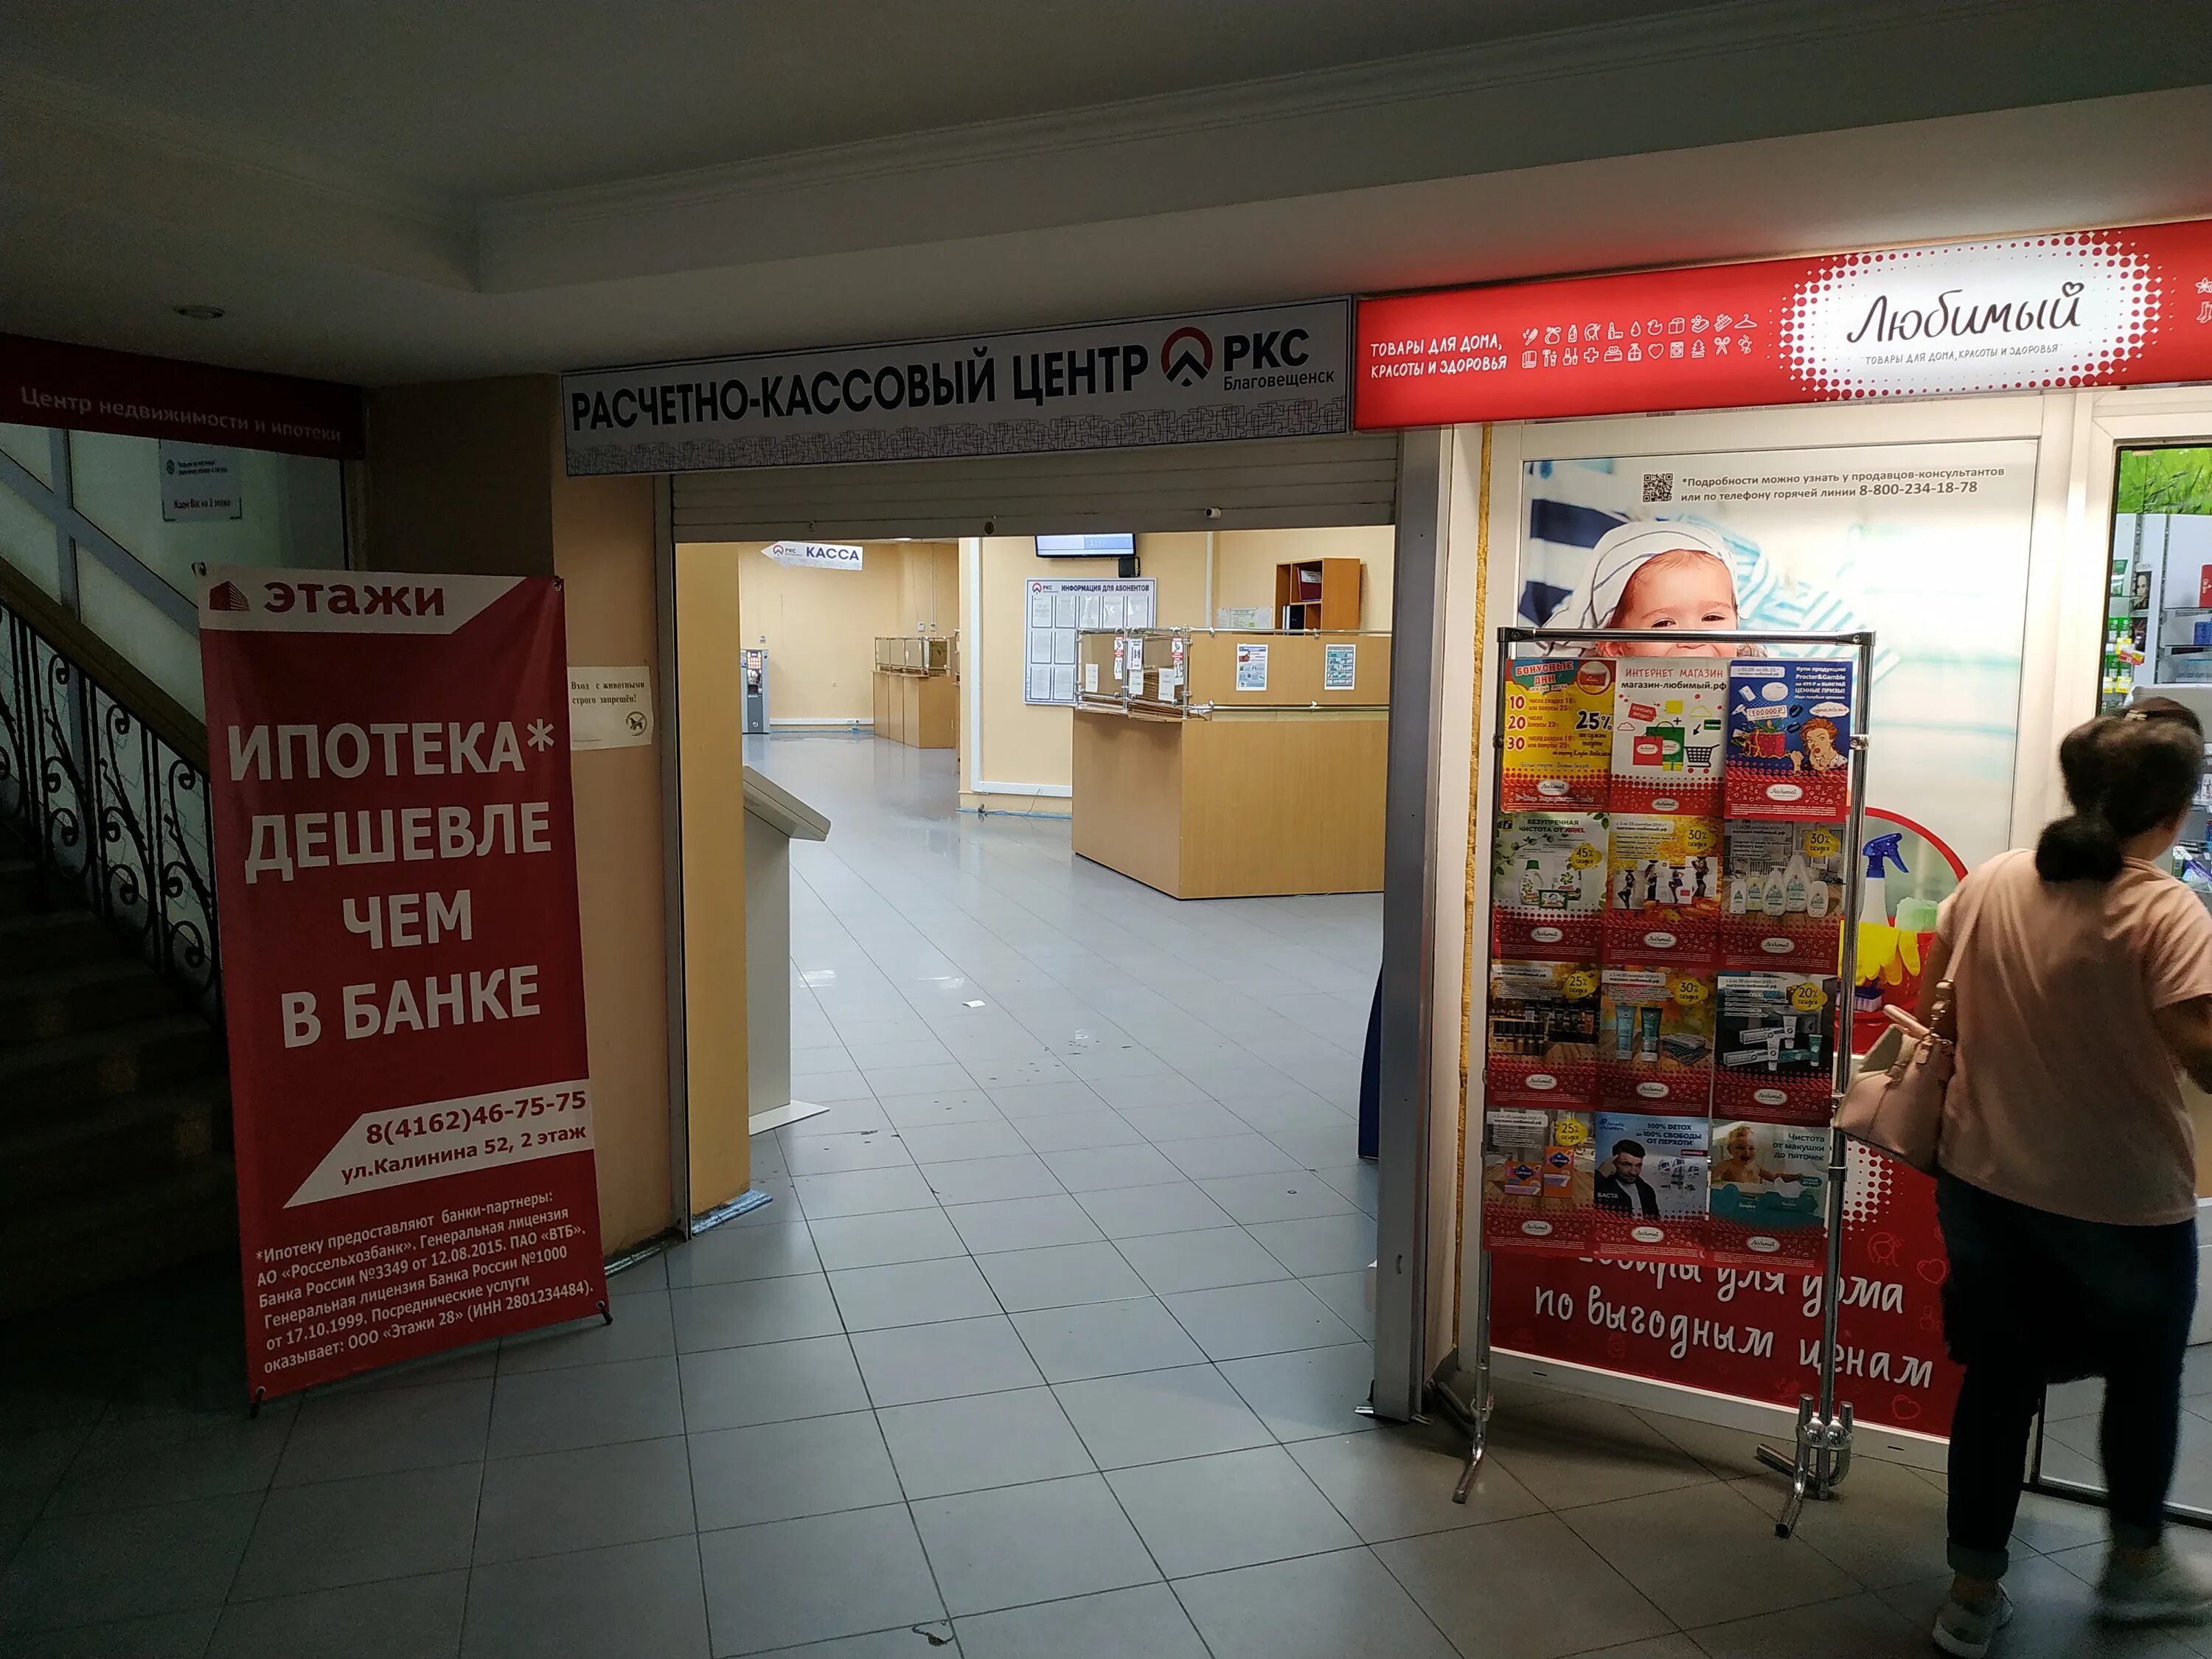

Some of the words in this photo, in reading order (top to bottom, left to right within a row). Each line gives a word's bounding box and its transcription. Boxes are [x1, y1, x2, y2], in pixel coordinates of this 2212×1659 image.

[1846, 282, 2084, 344] Любимый
[1224, 328, 1309, 372] РКС
[1371, 337, 1425, 358] ТОВАРЫ
[1427, 335, 1457, 355] ДЛЯ
[1460, 333, 1503, 352] ДОМА,
[1865, 354, 1903, 366] ТОВАРЫ
[1905, 352, 1926, 364] ДЛЯ
[2000, 346, 2007, 356] И
[2009, 344, 2059, 356] ЗДОРОВЬЯ
[1371, 361, 1425, 379] КРАСОТЫ
[1428, 361, 1436, 375] И
[1440, 355, 1507, 374] ЗДОРОВЬЯ
[572, 346, 995, 431] РАСЧЕТНО-КАССОВЫЙ
[1013, 344, 1148, 406] ЦЕНТР
[1224, 371, 1335, 392] Благовещенск
[21, 386, 92, 415] Центр
[100, 400, 248, 431] недвижимости
[254, 420, 265, 433] и
[272, 421, 341, 442] ипотеки
[1761, 476, 1800, 484] можно
[1803, 474, 1840, 485] узнать
[1842, 476, 1848, 484] у
[1851, 467, 2005, 483] продавцов-консультантов
[1681, 494, 1700, 502] или
[1703, 493, 1717, 501] по
[1719, 490, 1771, 503] телефону
[1773, 487, 1818, 501] горячей
[1820, 487, 1856, 498] линии
[1859, 481, 1978, 497] 8-800-234-18-78
[806, 546, 859, 560] КАССА
[1061, 585, 1102, 593] ИНФОРМАЦИЯ
[1102, 585, 1114, 593] ДЛЯ
[1516, 661, 1573, 675] БОНУСНЫЕ
[1625, 668, 1674, 678] ИНТЕРНЕТ
[1680, 668, 1723, 678] МАГАЗИН
[571, 681, 589, 690] Вход
[1621, 681, 1727, 691] магазин-любимый.рф
[572, 697, 597, 706] строго
[600, 694, 637, 705] запрещён!
[1509, 695, 1526, 710] 10
[1507, 715, 1526, 731] 20
[1575, 710, 1613, 731] 25%
[1506, 736, 1526, 751] 30
[244, 801, 552, 885] ДЕШЕВЛЕ
[1688, 830, 1707, 840] 30%
[1811, 834, 1830, 844] 30%
[1576, 848, 1593, 858] 45%
[342, 888, 473, 950] ЧЕМ
[1570, 976, 1587, 987] 25%
[1680, 983, 1698, 993] 30%
[1798, 987, 1818, 998] 20%
[281, 991, 321, 1048] В
[342, 964, 540, 1040] БАНКЕ
[366, 1091, 587, 1145] 8(4162)46-75-75
[1562, 1124, 1579, 1134] 25%
[1788, 1133, 1825, 1142] Чистота
[341, 1144, 478, 1184] ул.Калинина
[484, 1136, 514, 1155] 52,
[521, 1133, 532, 1148] 2
[538, 1124, 587, 1145] этаж
[1785, 1144, 1825, 1152] макушки
[327, 1215, 434, 1248] предоставляют
[442, 1191, 553, 1223] банки-партнеры:
[257, 1271, 277, 1287] АО
[282, 1241, 417, 1280] «Россельхозбанк».
[420, 1221, 504, 1248] Генеральная
[507, 1207, 569, 1230] лицензия
[259, 1288, 302, 1308] Банка
[306, 1275, 355, 1298] России
[359, 1262, 408, 1284] №3349
[412, 1260, 427, 1271] от
[431, 1238, 507, 1267] 12.08.2015.
[509, 1233, 537, 1248] ПАО
[540, 1224, 585, 1244] «ВТБ».
[265, 1300, 355, 1329] Генеральная
[359, 1279, 425, 1305] лицензия
[429, 1269, 469, 1288] Банка
[473, 1257, 518, 1279] России
[521, 1245, 567, 1266] №1000
[266, 1338, 282, 1351] от
[286, 1313, 368, 1344] 17.10.1999.
[372, 1286, 483, 1323] Посреднические
[487, 1275, 529, 1296] услуги
[1534, 1286, 1573, 1321] по
[1588, 1284, 1774, 1359] выгодным
[265, 1340, 344, 1373] оказывает:
[348, 1330, 379, 1349] ООО
[383, 1319, 434, 1341] «Этажи
[439, 1310, 464, 1326] 28»
[467, 1302, 502, 1324] (ИНН
[505, 1279, 594, 1312] 2801234484).
